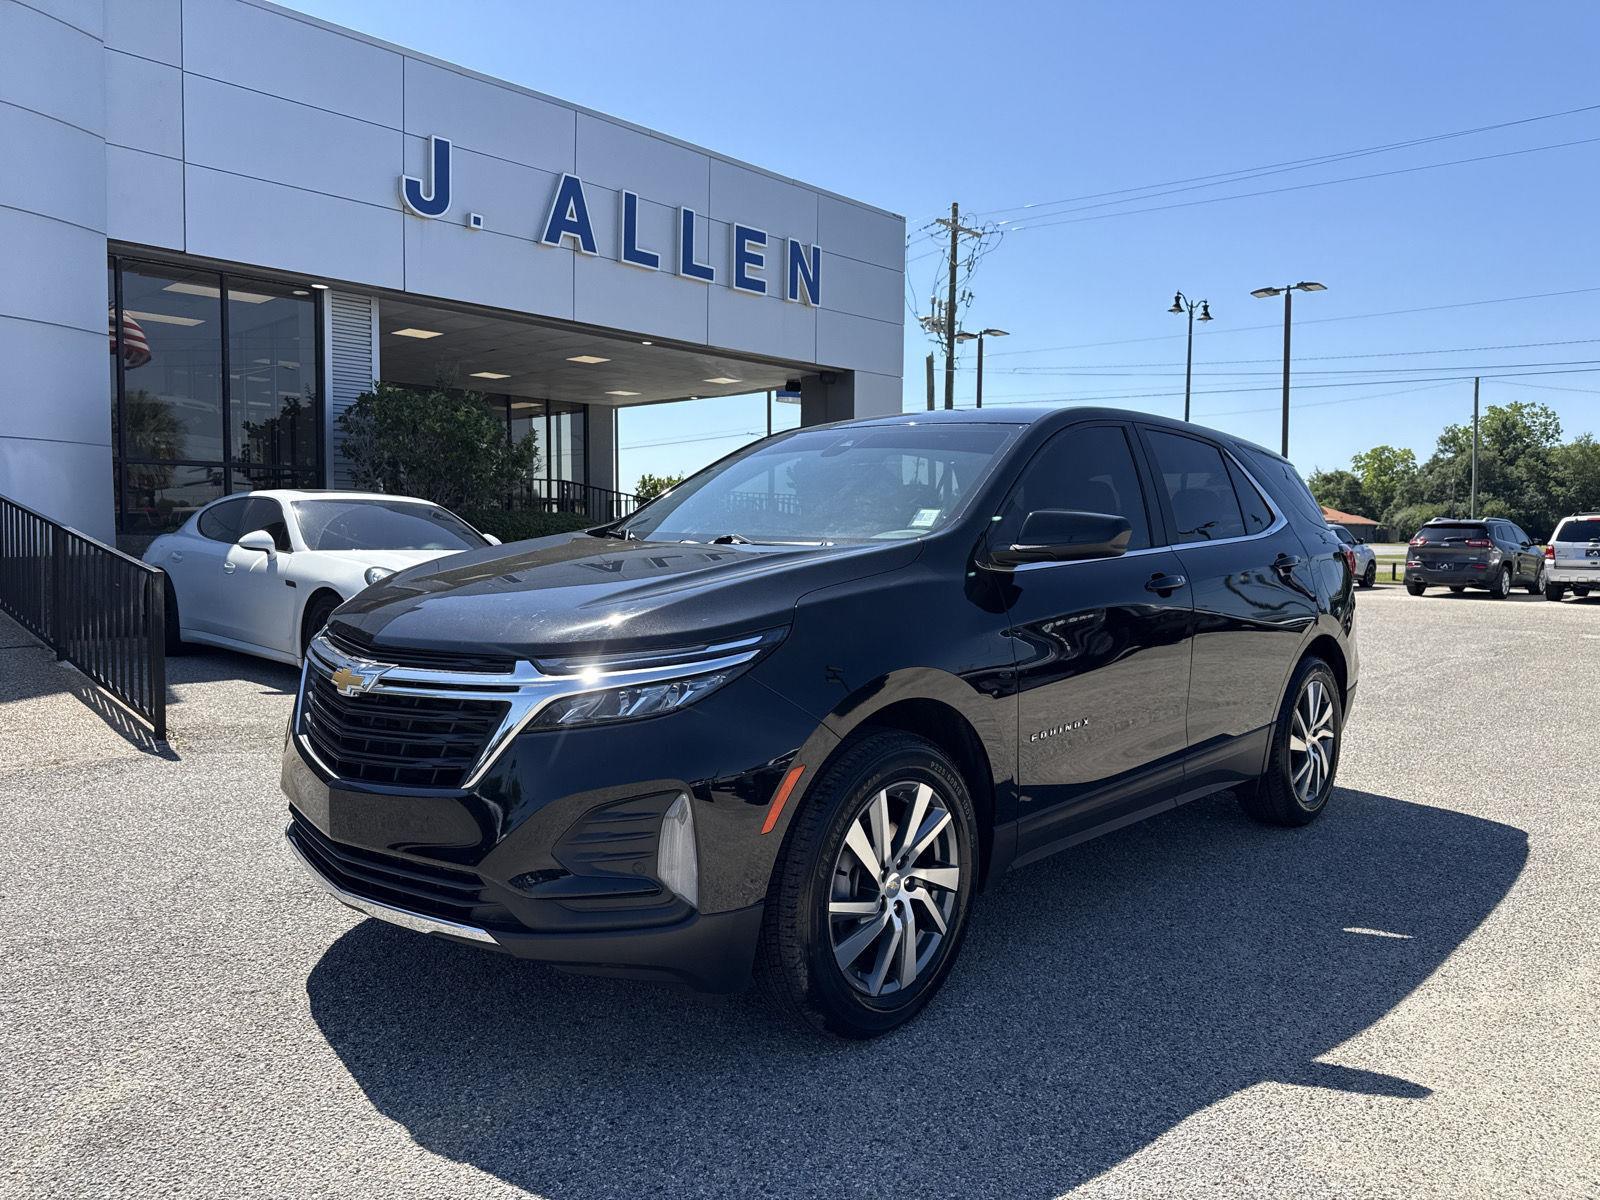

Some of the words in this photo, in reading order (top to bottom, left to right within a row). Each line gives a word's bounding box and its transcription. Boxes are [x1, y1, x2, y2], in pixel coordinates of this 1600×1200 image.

[400, 135, 484, 230] J.
[540, 172, 822, 308] ALLEN
[1029, 717, 1089, 743] EQUINOX
